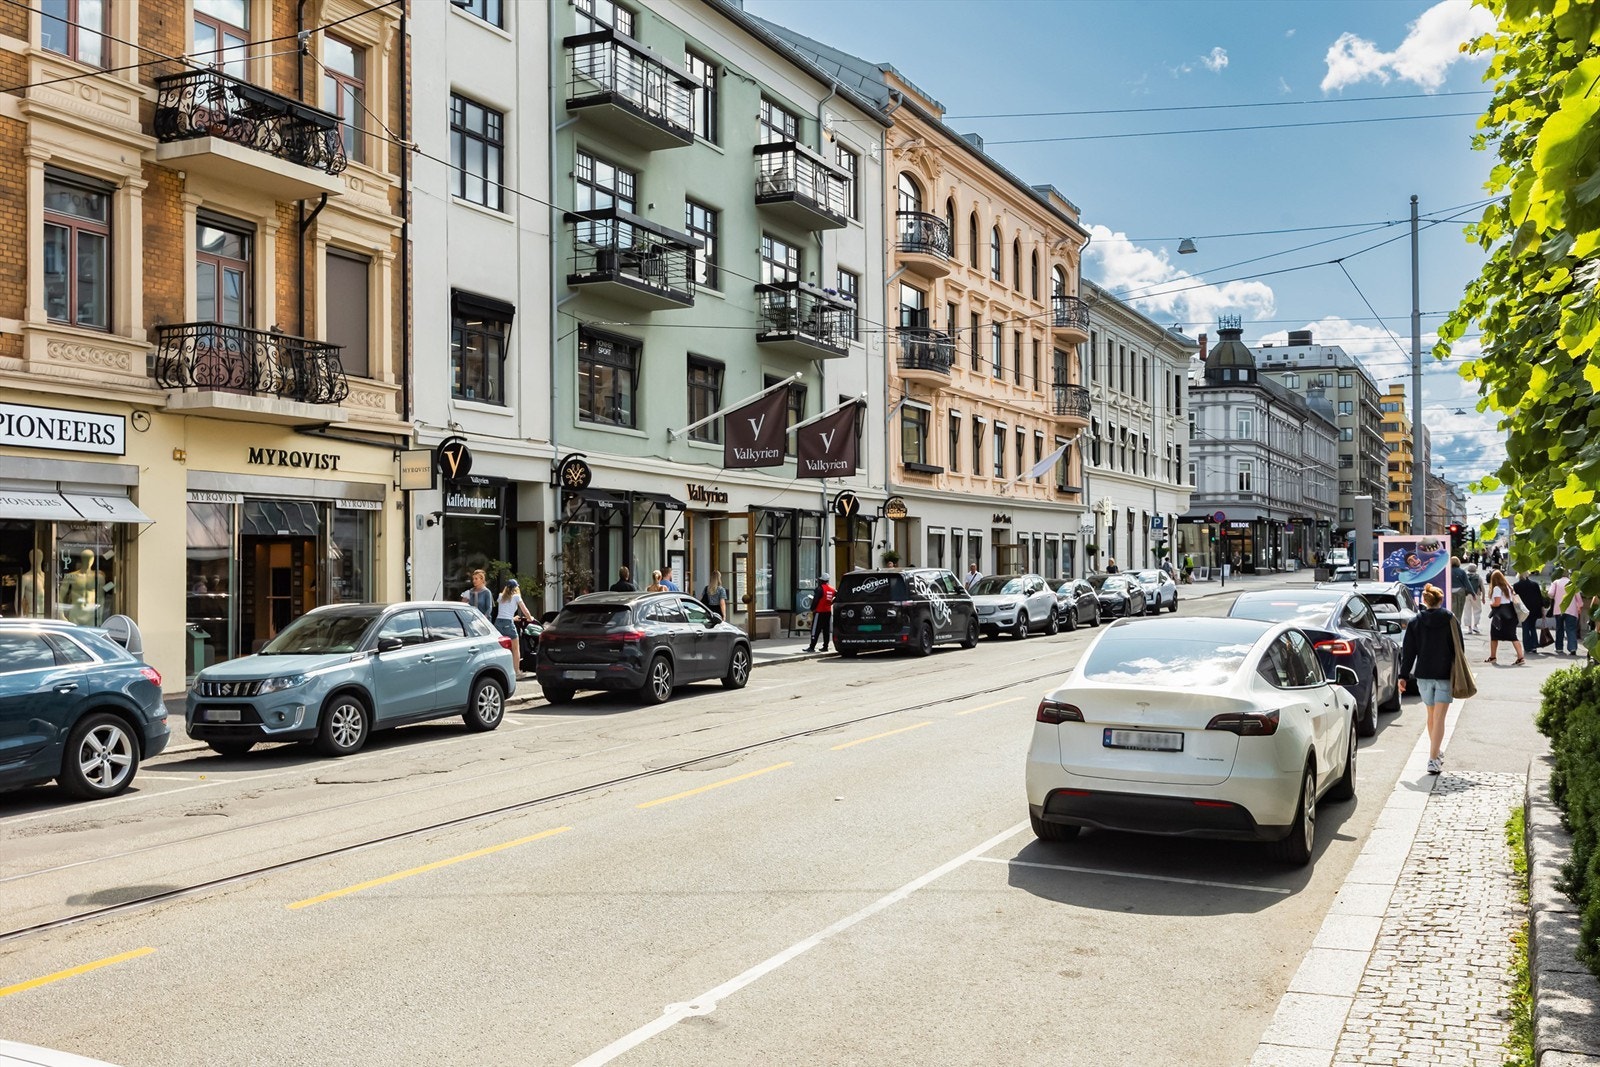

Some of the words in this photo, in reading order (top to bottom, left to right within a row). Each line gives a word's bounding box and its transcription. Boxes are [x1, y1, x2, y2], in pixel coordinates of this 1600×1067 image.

[248, 447, 341, 471] MYRQVIST
[733, 447, 779, 462] Valkyrien
[806, 459, 848, 473] Valkyrien
[0, 497, 62, 507] IONEERS
[191, 492, 238, 502] MYRQVIST
[446, 493, 497, 510] Kaffebrenneriet
[687, 484, 729, 507] Valkyrien
[340, 500, 378, 509] MYRQVIST
[1153, 518, 1161, 528] P
[852, 578, 889, 594] FOODTECH
